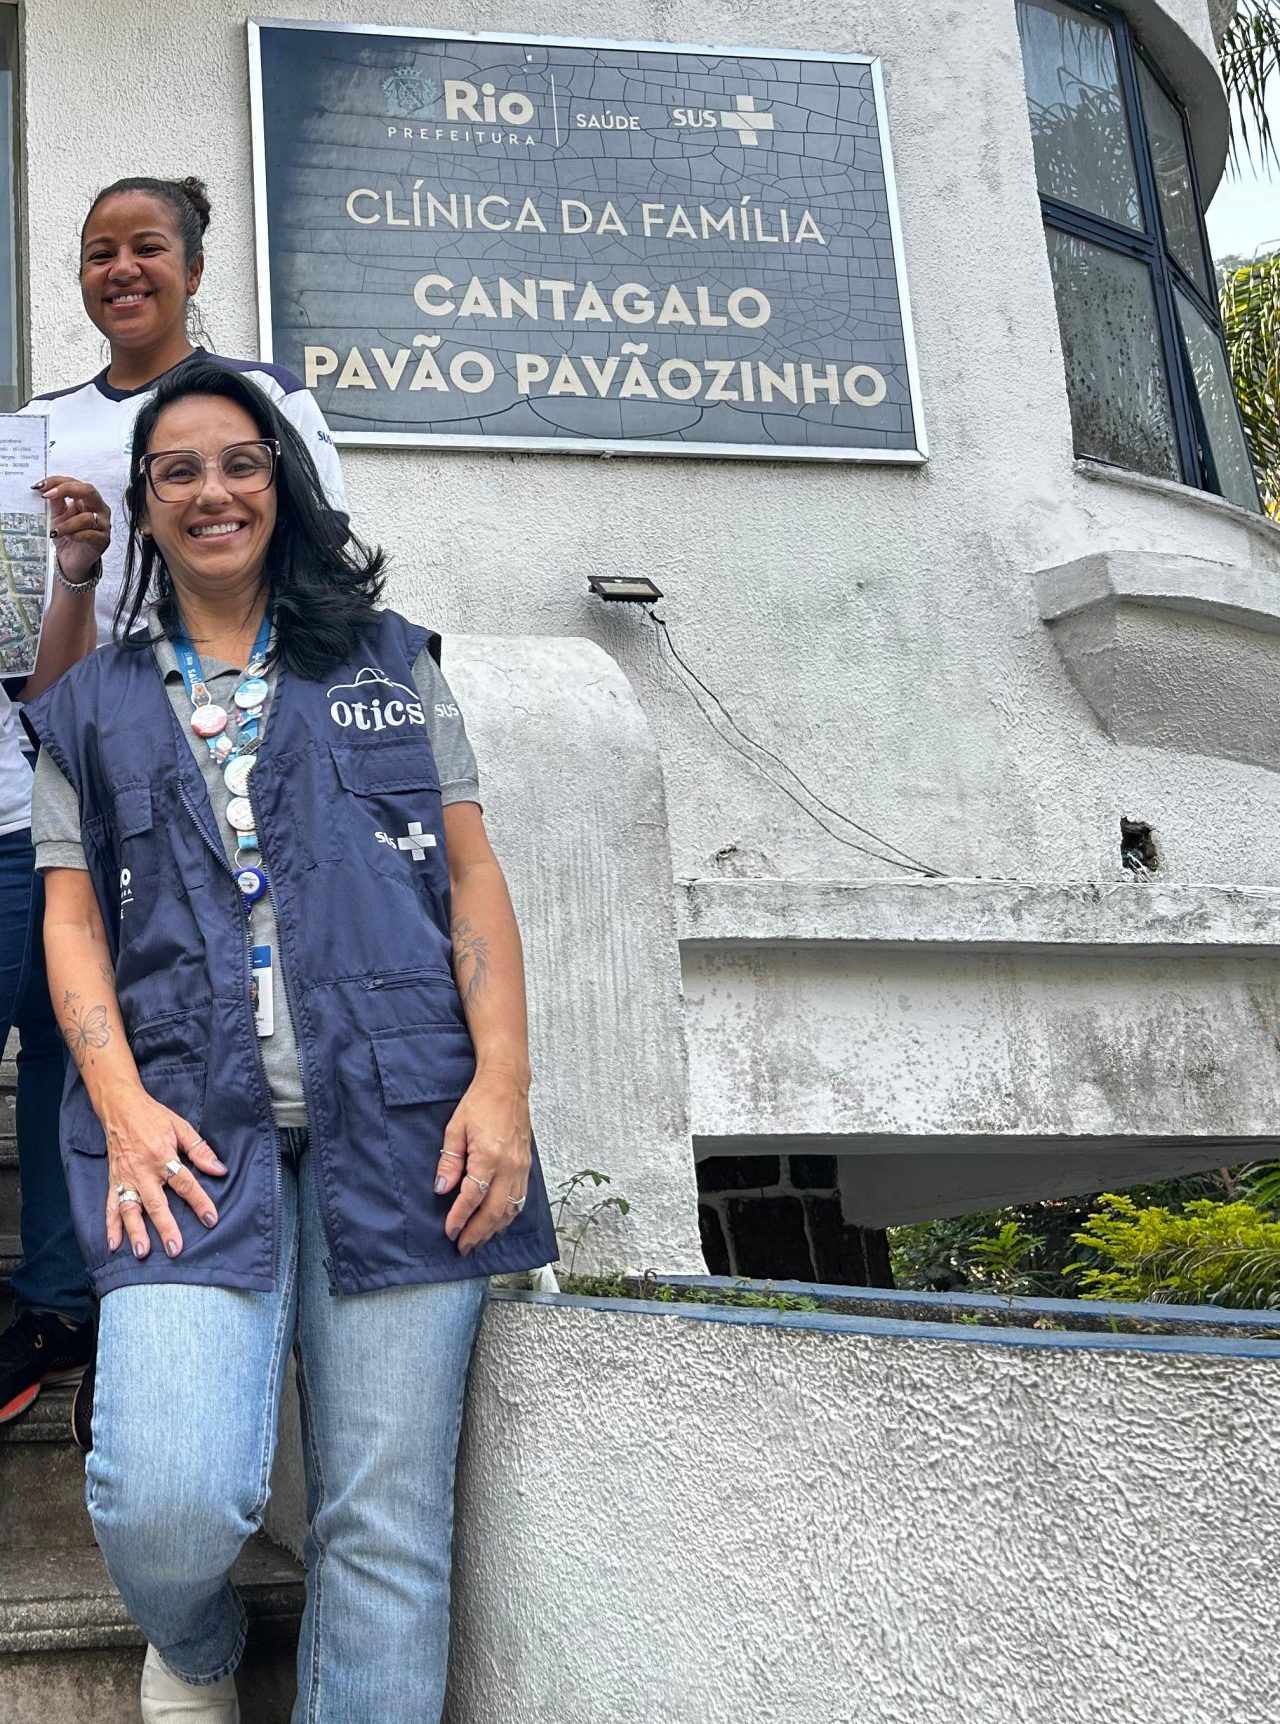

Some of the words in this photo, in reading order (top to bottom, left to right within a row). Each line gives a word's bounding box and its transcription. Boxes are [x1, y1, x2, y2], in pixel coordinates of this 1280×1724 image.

[443, 79, 535, 125] Rio
[672, 108, 718, 128] SUS
[388, 126, 536, 146] PREFEITURA
[576, 110, 641, 131] SAÚDE
[345, 179, 547, 235] CLÍNICA
[561, 199, 629, 238] DA
[642, 195, 826, 246] FAMÍLIA
[413, 273, 772, 328] CANTAGALO
[303, 335, 495, 394] PAVÃO
[516, 342, 887, 407] PAVÃOZINHO
[434, 702, 460, 718] SUS
